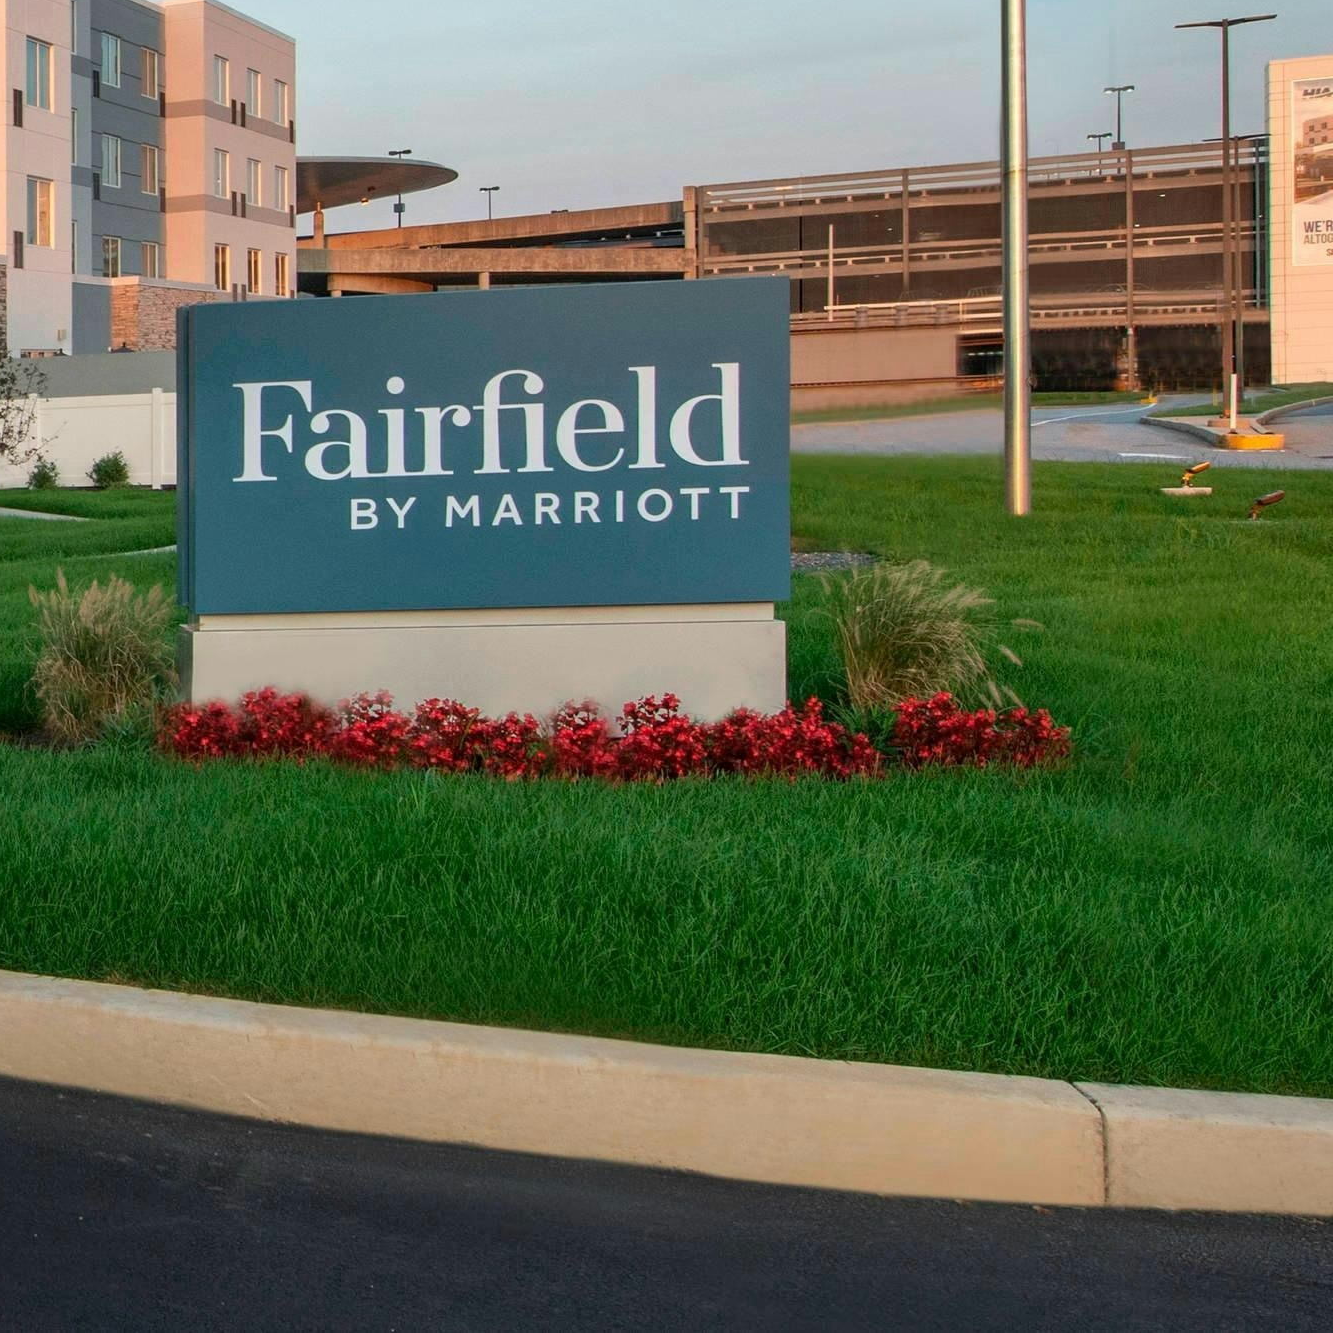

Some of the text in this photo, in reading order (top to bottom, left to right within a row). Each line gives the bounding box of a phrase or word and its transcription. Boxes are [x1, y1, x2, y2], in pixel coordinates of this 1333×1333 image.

[232, 362, 750, 482] Fairfield
[350, 486, 750, 530] BY MARRIOTT
